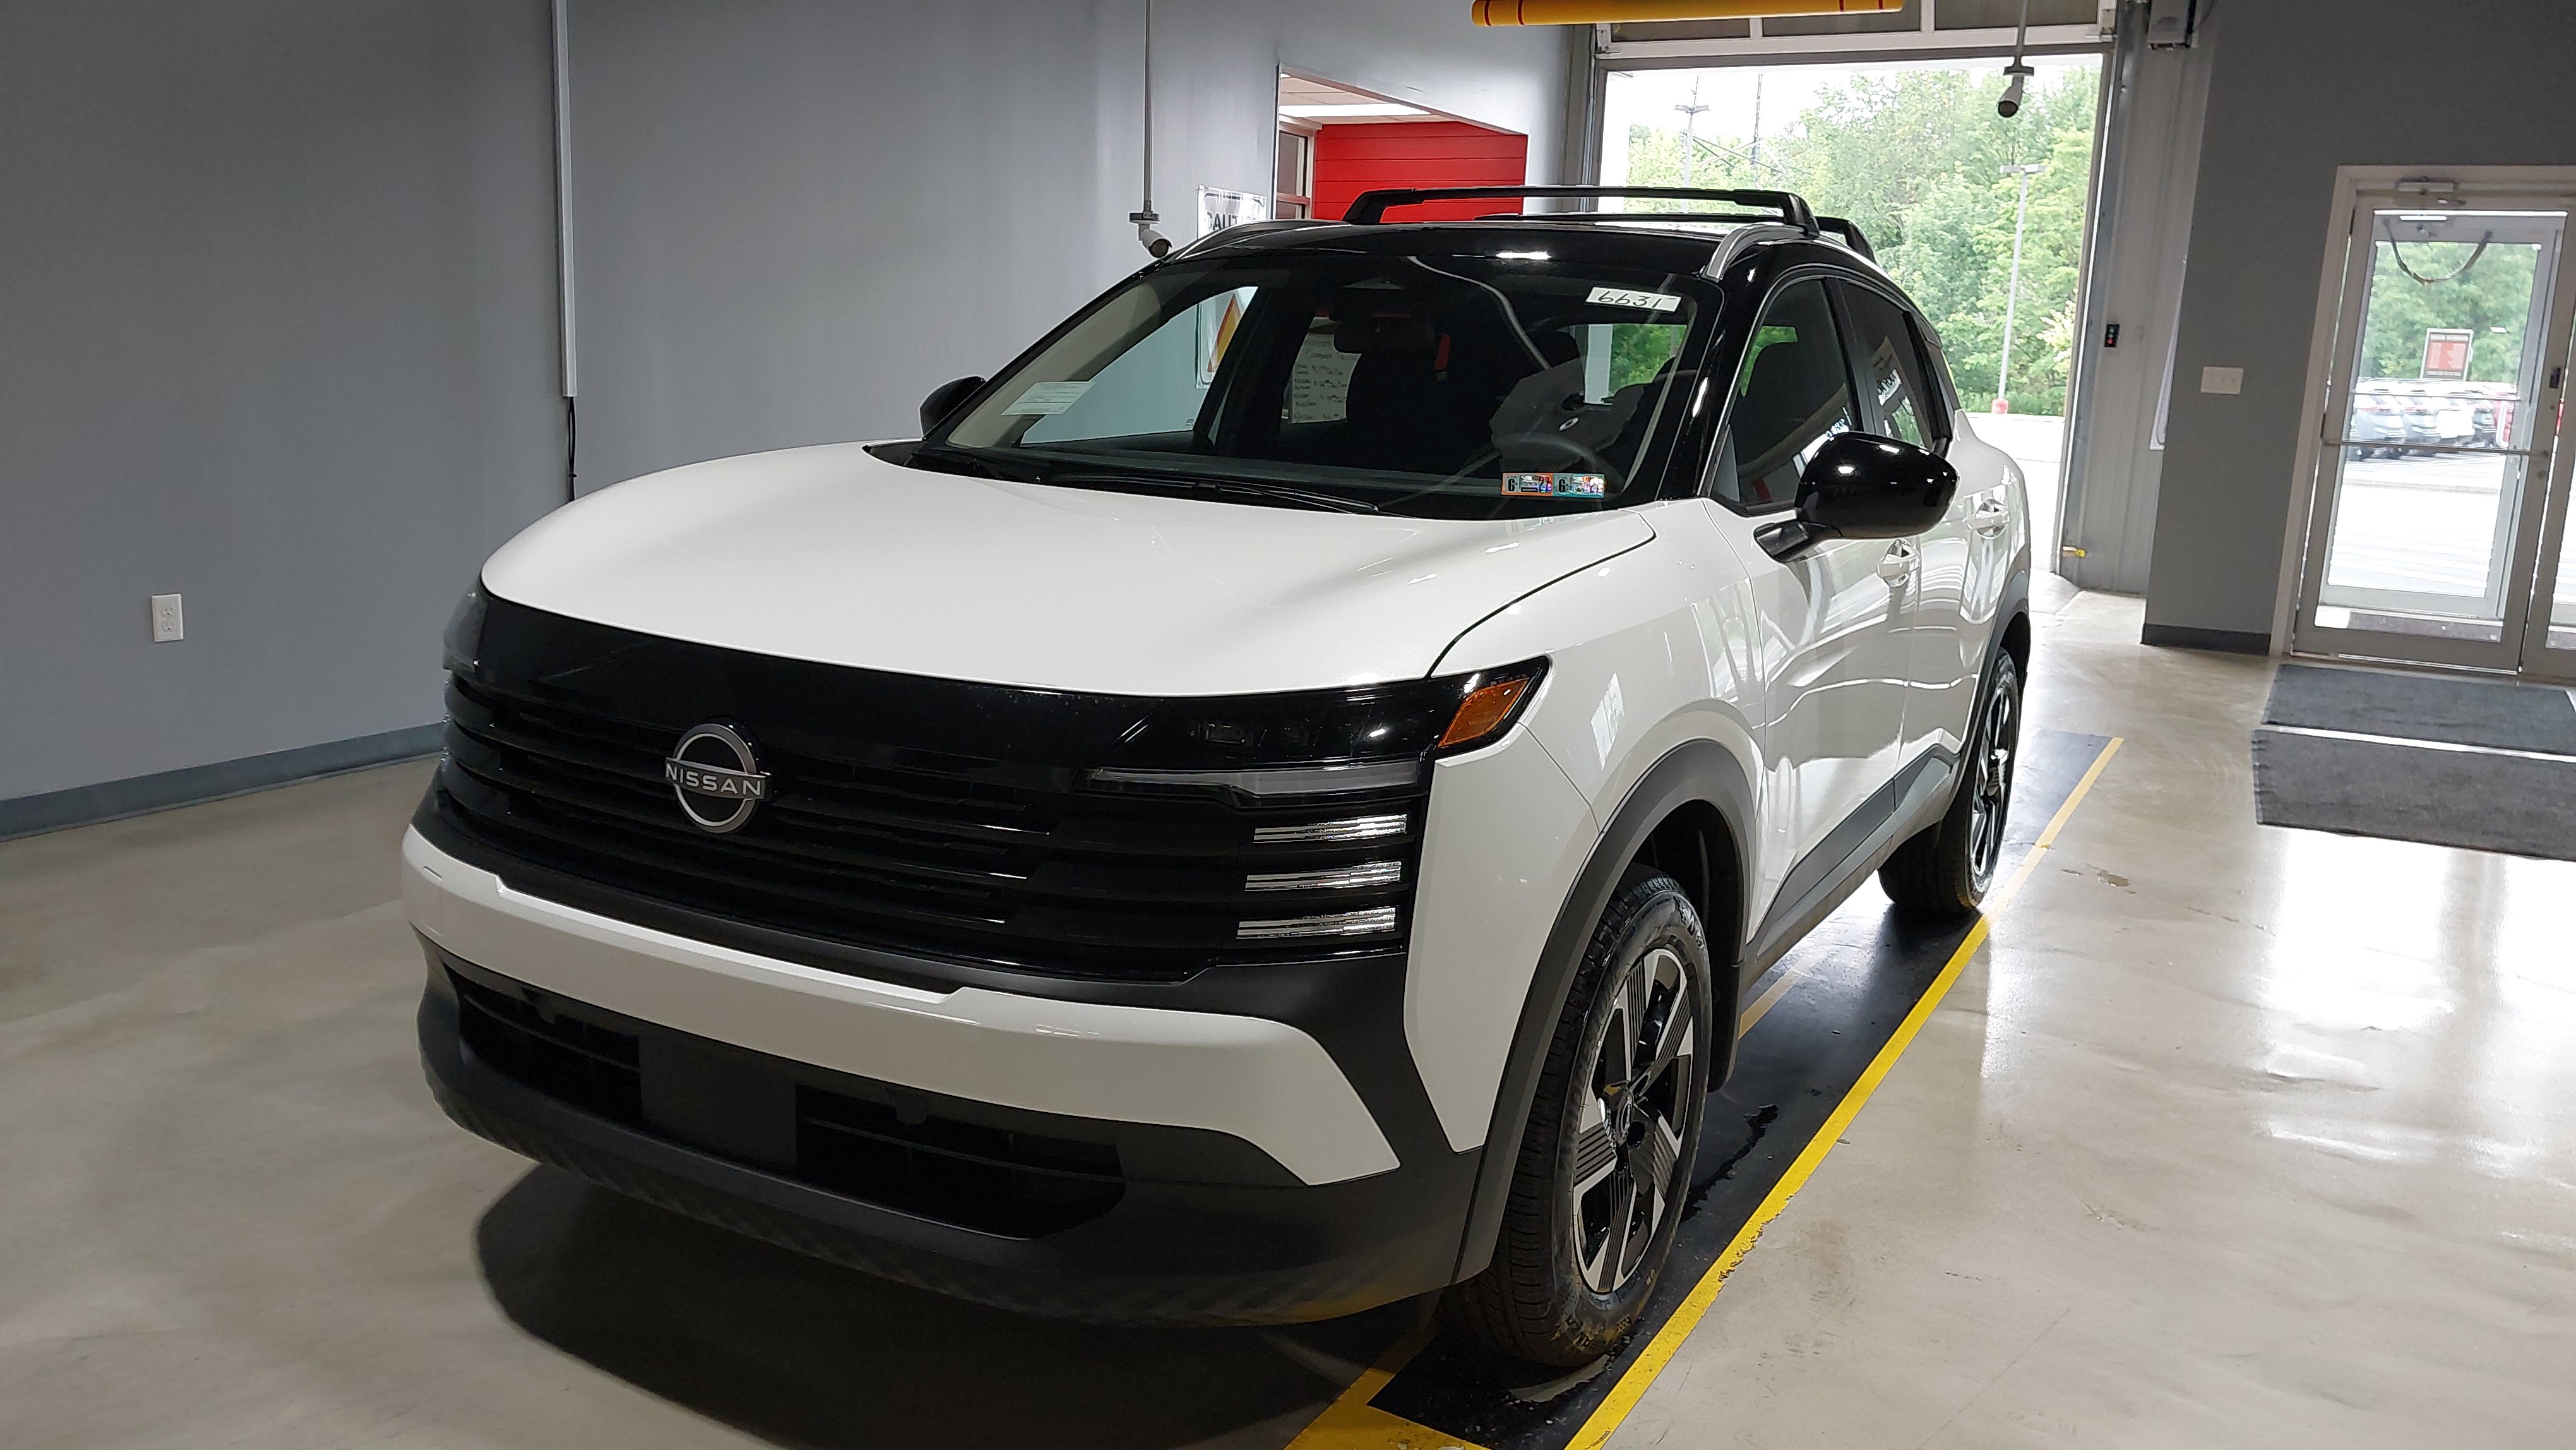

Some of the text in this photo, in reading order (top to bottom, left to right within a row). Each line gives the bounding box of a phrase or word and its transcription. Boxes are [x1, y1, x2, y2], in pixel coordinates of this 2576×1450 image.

[1597, 291, 1663, 308] 6631
[1507, 478, 1515, 492] 6
[1558, 479, 1566, 493] 6
[665, 763, 761, 796] NISSAN
